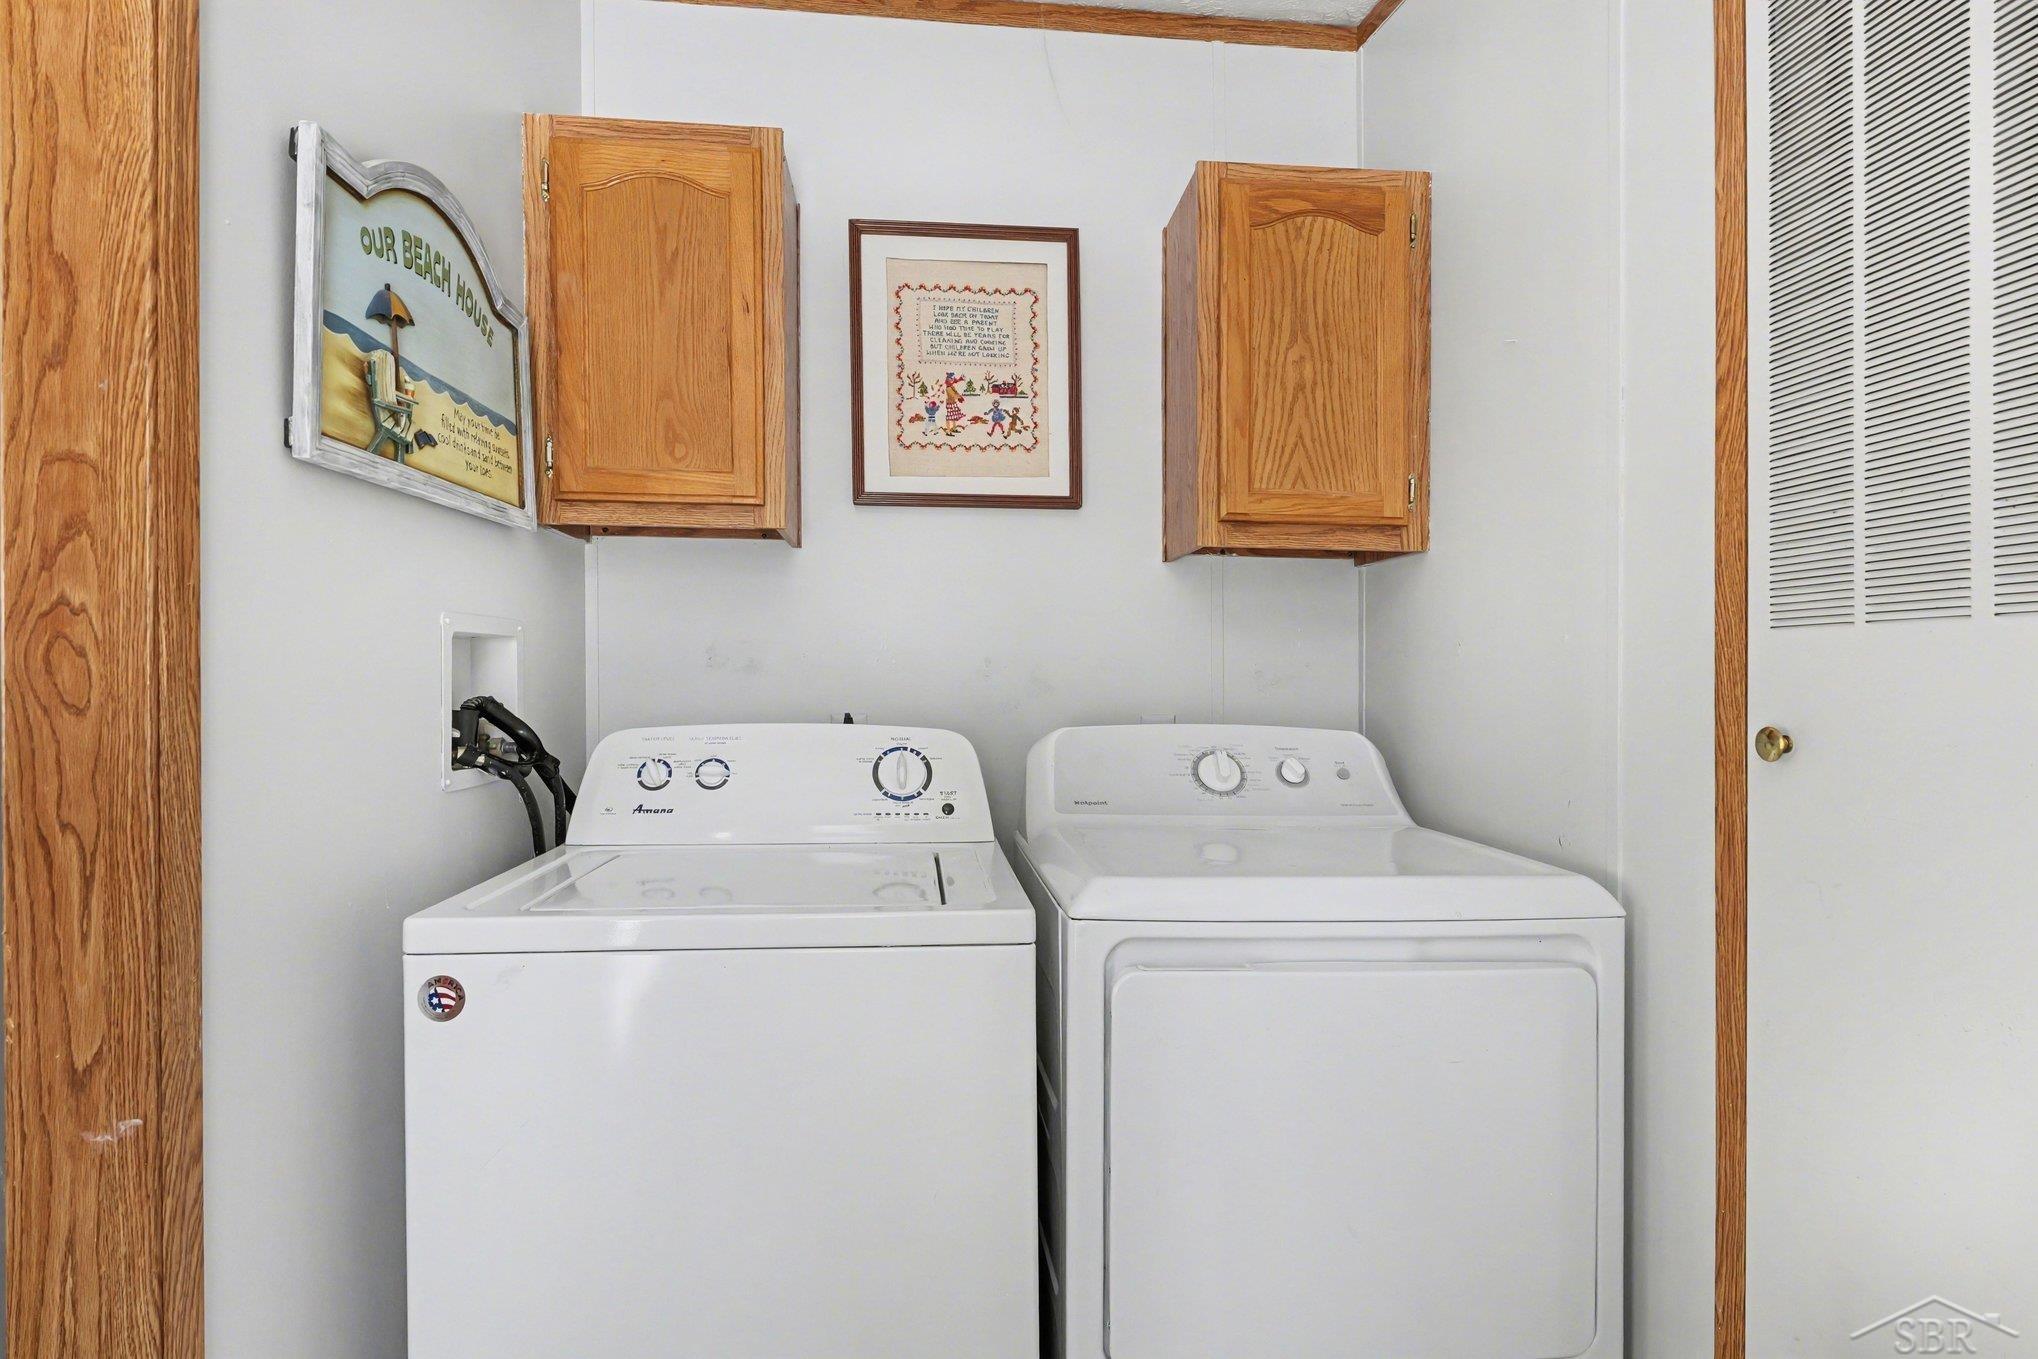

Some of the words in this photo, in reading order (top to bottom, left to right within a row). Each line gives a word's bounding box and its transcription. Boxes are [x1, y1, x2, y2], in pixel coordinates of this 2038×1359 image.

[360, 226, 398, 264] OUR
[401, 229, 451, 298] BEACH
[456, 273, 494, 348] HOUSE
[632, 804, 675, 815] Amana
